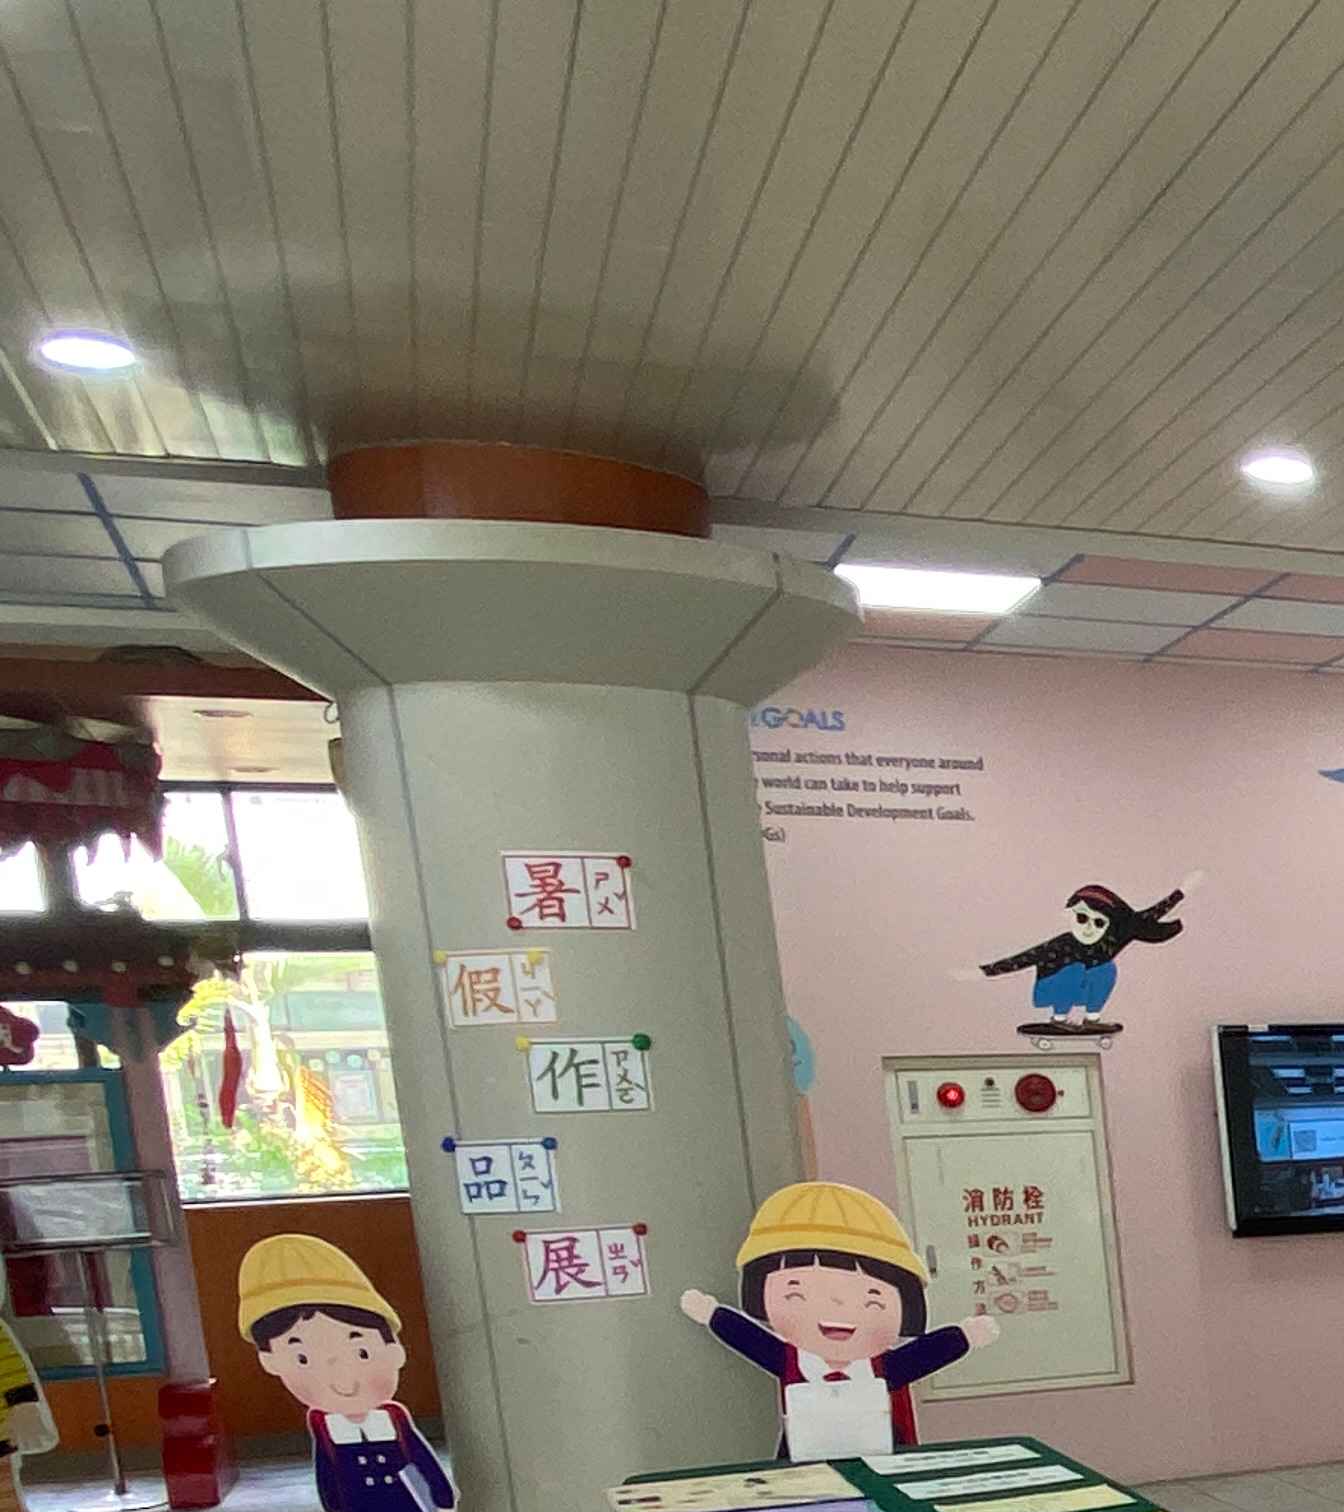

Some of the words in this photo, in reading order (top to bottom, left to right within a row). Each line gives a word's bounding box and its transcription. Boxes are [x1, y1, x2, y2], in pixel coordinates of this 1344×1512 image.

[762, 706, 845, 731] GOALS
[795, 751, 842, 766] actions
[845, 752, 873, 768] that
[876, 756, 935, 772] everyone
[938, 756, 984, 771] around
[762, 776, 801, 791] world
[804, 780, 828, 791] can
[831, 776, 859, 793] take
[863, 778, 877, 793] to
[879, 779, 909, 796] help
[911, 781, 961, 797] support
[765, 801, 844, 817] Sustainable
[847, 804, 934, 821] Development
[937, 806, 975, 821] Goals.
[514, 861, 581, 923] 暑
[450, 964, 514, 1017] 假
[536, 1047, 601, 1106] 作
[463, 1156, 508, 1202] 品
[962, 1185, 1044, 1212] 消防栓
[967, 1212, 1044, 1227] HYDRANT
[535, 1237, 604, 1295] 展
